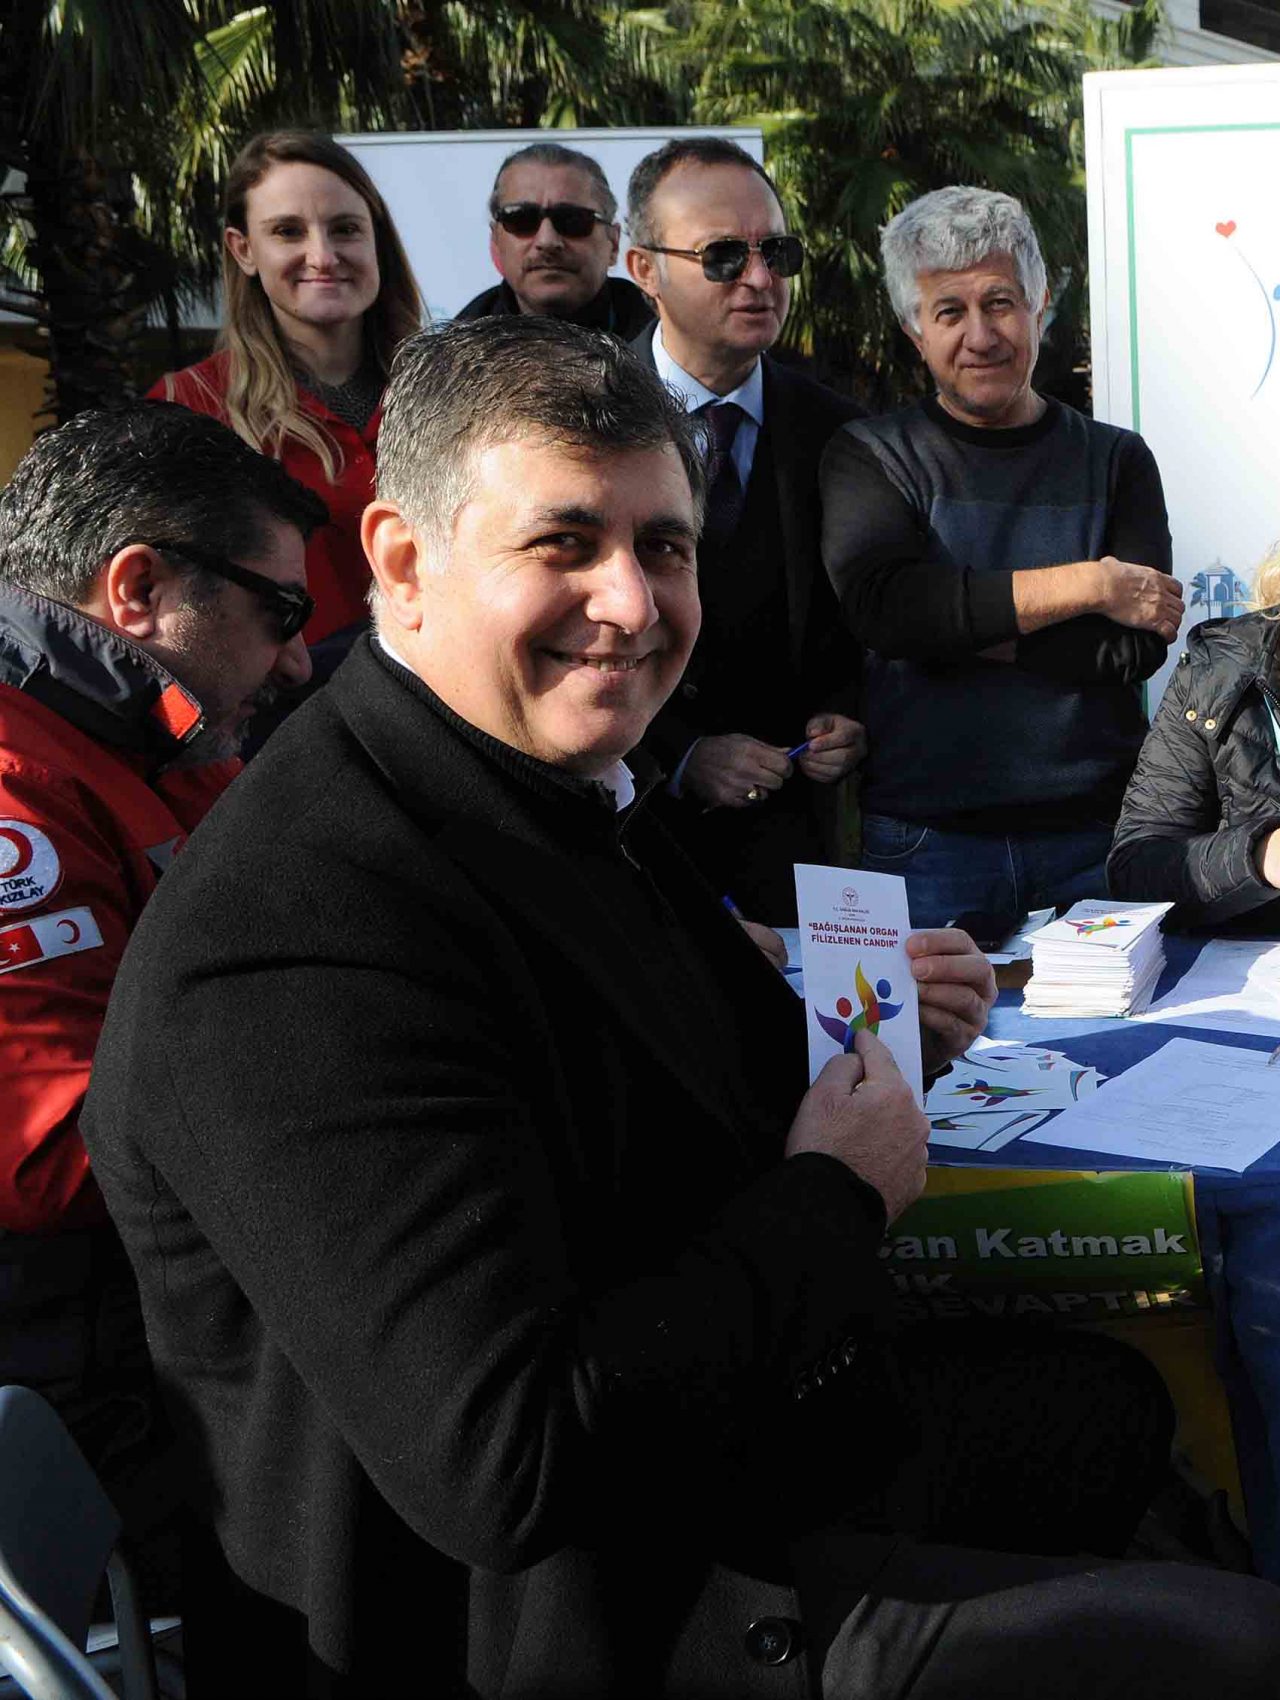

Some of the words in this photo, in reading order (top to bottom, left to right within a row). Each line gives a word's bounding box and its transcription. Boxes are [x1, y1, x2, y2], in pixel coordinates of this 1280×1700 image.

[870, 927, 898, 937] ORGAN
[877, 1235, 958, 1260] an
[975, 1227, 1188, 1260] Katmak
